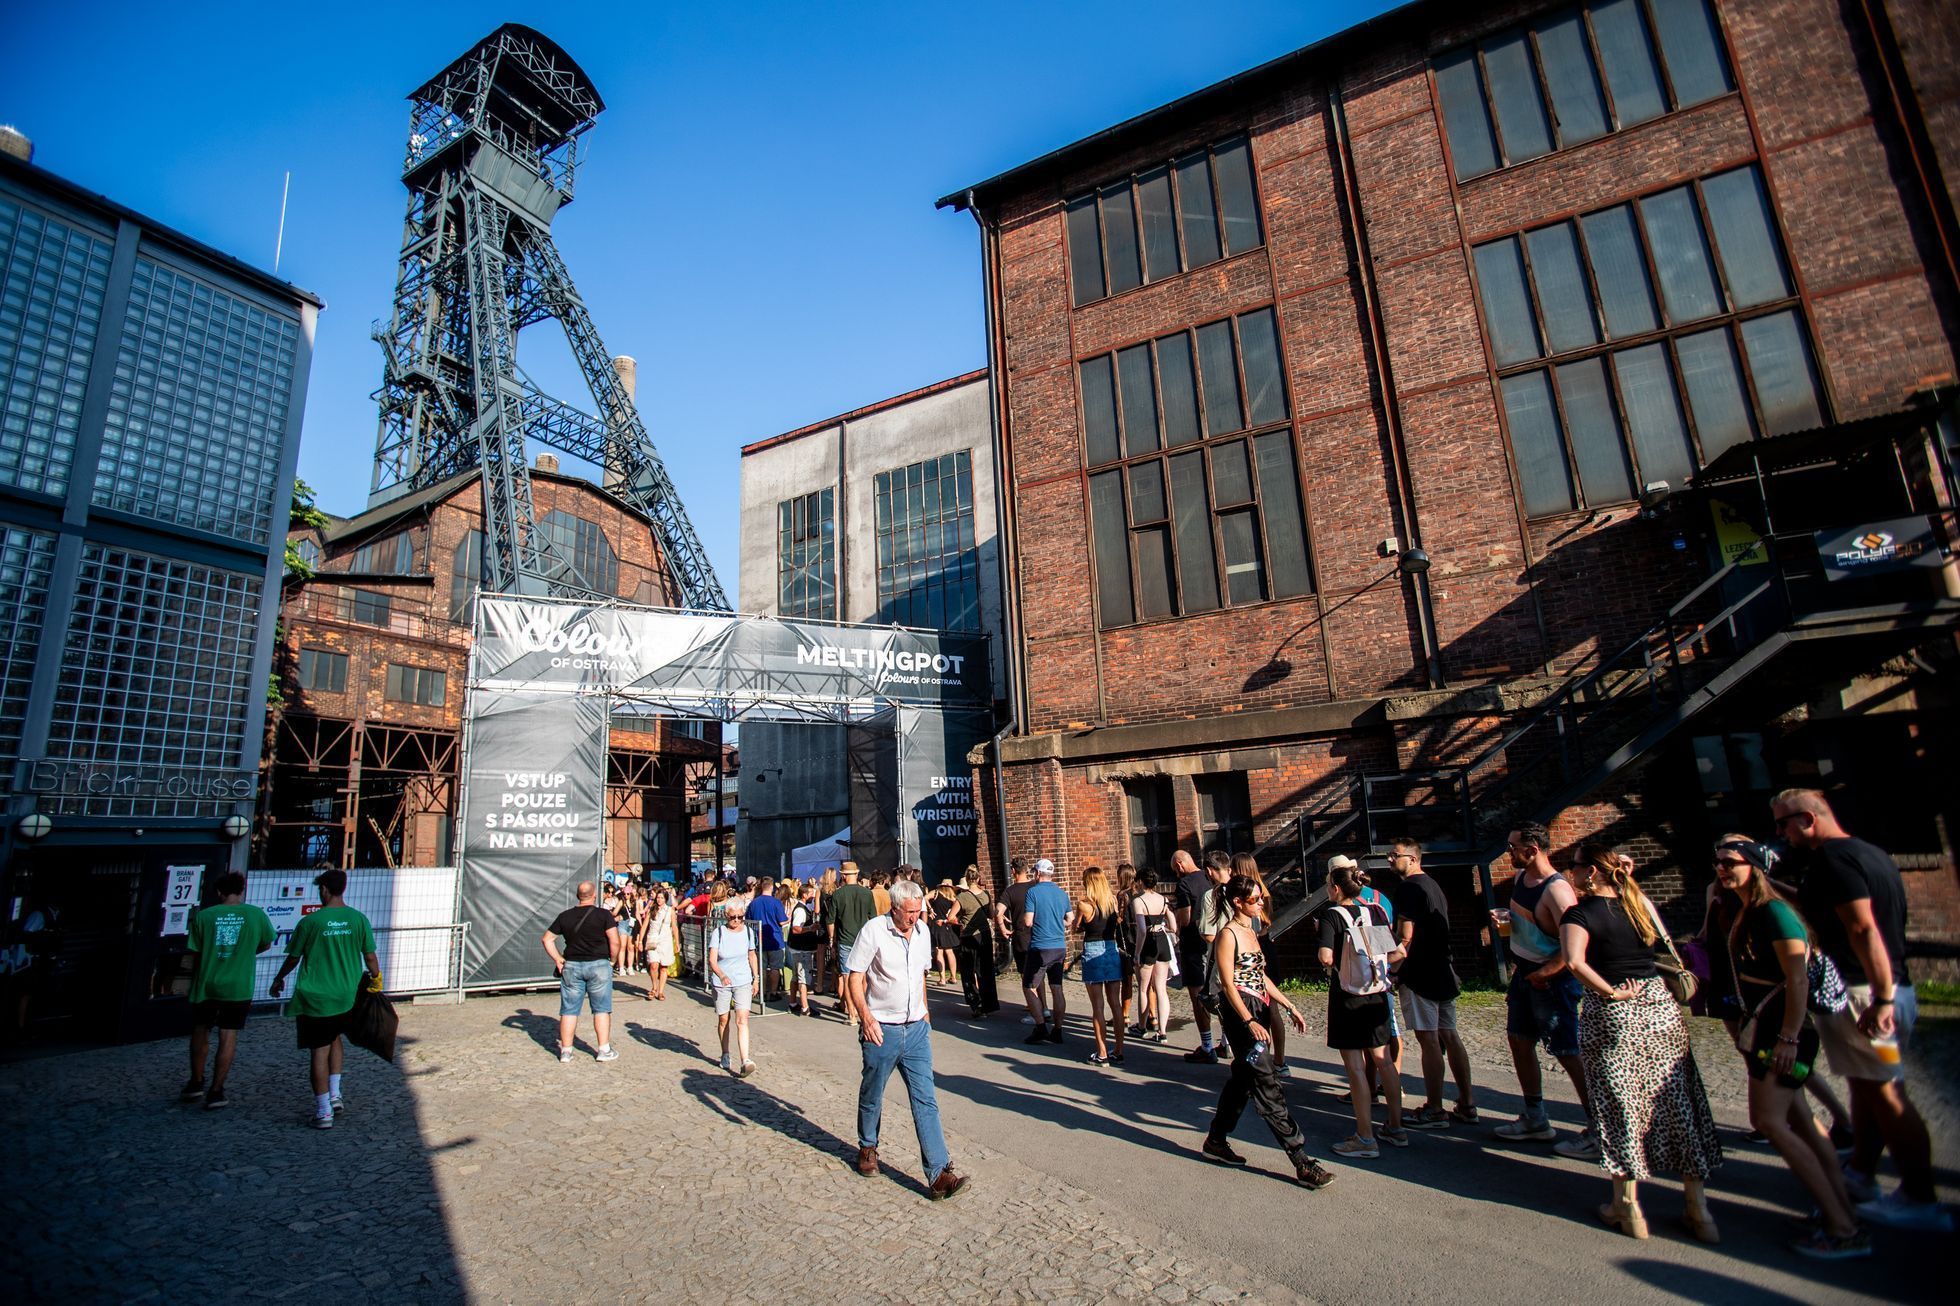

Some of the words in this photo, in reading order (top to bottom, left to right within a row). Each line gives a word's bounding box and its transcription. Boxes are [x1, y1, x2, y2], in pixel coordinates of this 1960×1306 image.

[522, 618, 654, 658] Colour
[550, 657, 570, 668] OF
[572, 658, 636, 671] OSTRAVA
[797, 644, 964, 674] MELTINGPOT
[880, 671, 919, 685] Colours
[931, 678, 962, 686] OSTRAVA
[504, 773, 566, 788] VSTUP
[930, 776, 972, 789] ENTRY
[502, 793, 566, 808] POUZE
[934, 792, 970, 805] WITH
[485, 813, 498, 828] S
[502, 810, 579, 828] PÁSKOU
[936, 825, 971, 837] ONLY
[489, 833, 518, 849] NA
[523, 832, 574, 848] RUCE
[174, 885, 192, 900] 37
